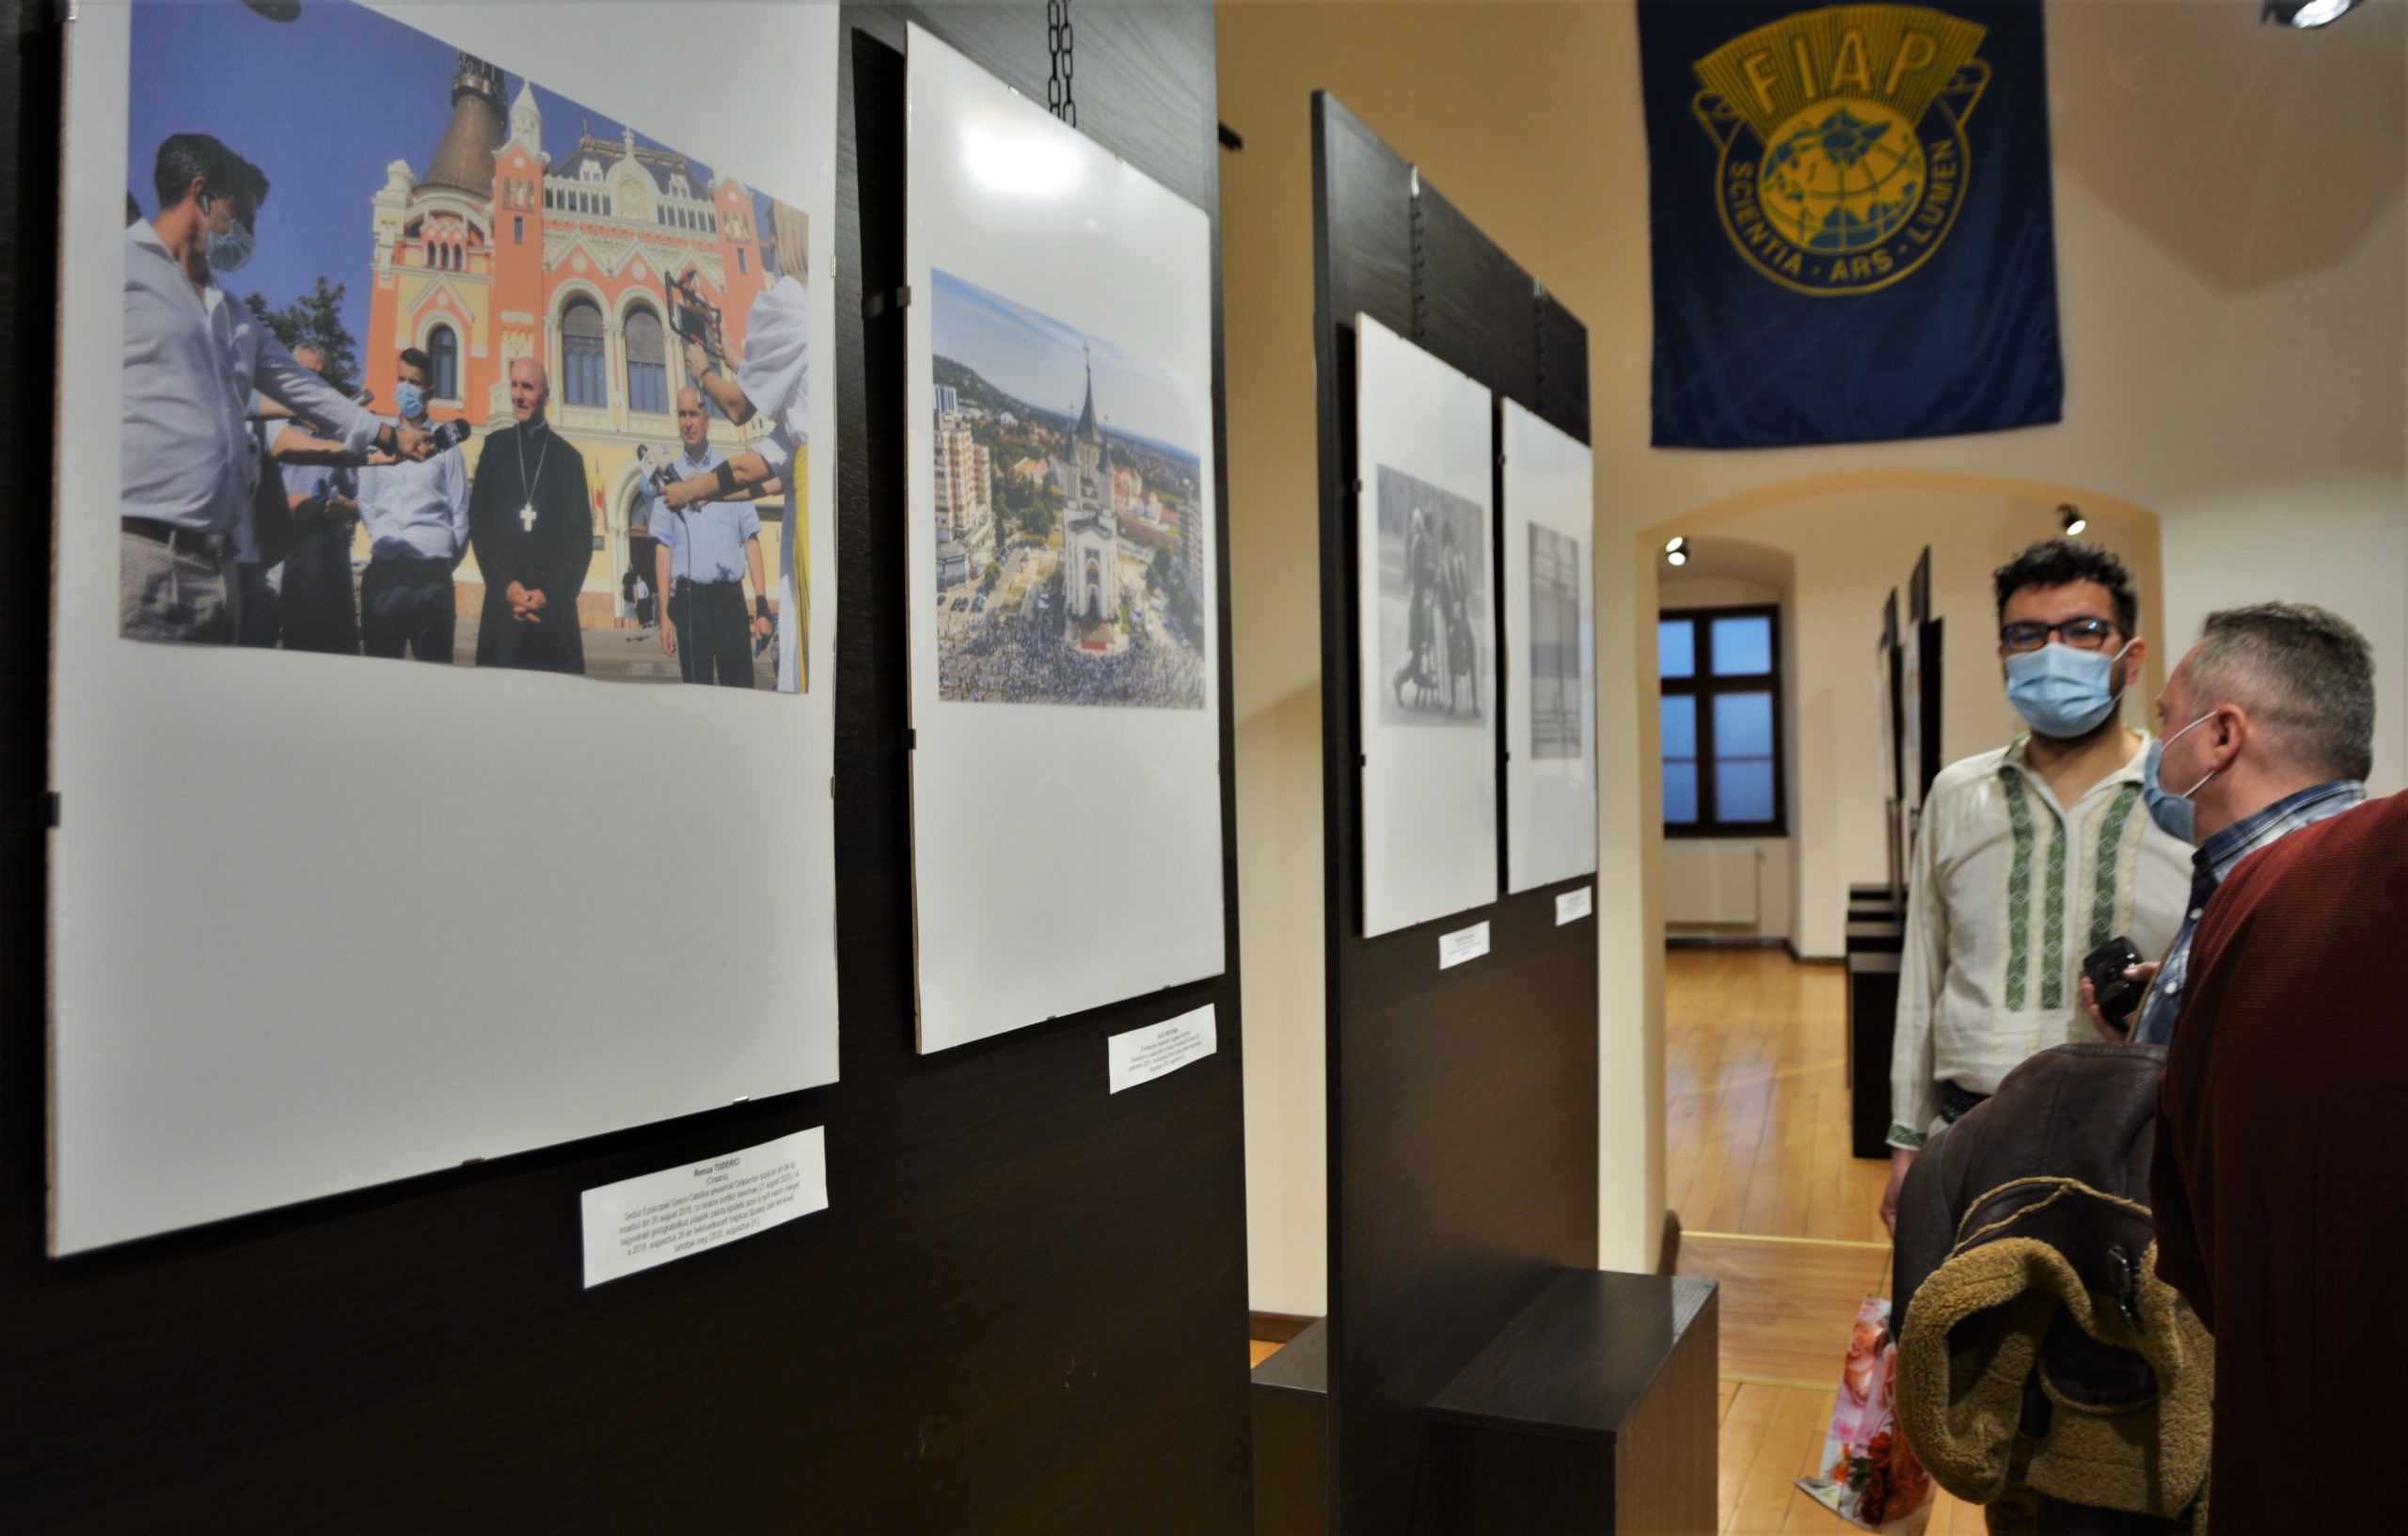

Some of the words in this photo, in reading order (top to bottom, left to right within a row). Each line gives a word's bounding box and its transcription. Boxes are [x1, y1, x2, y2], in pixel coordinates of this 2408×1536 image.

[1740, 27, 1939, 115] FIAP
[1729, 161, 1803, 276] SCIENTIA
[1829, 248, 1894, 282] ARS
[1906, 139, 1957, 244] LUMEN
[694, 1166, 713, 1177] Remus
[715, 1158, 740, 1171] TODERICI
